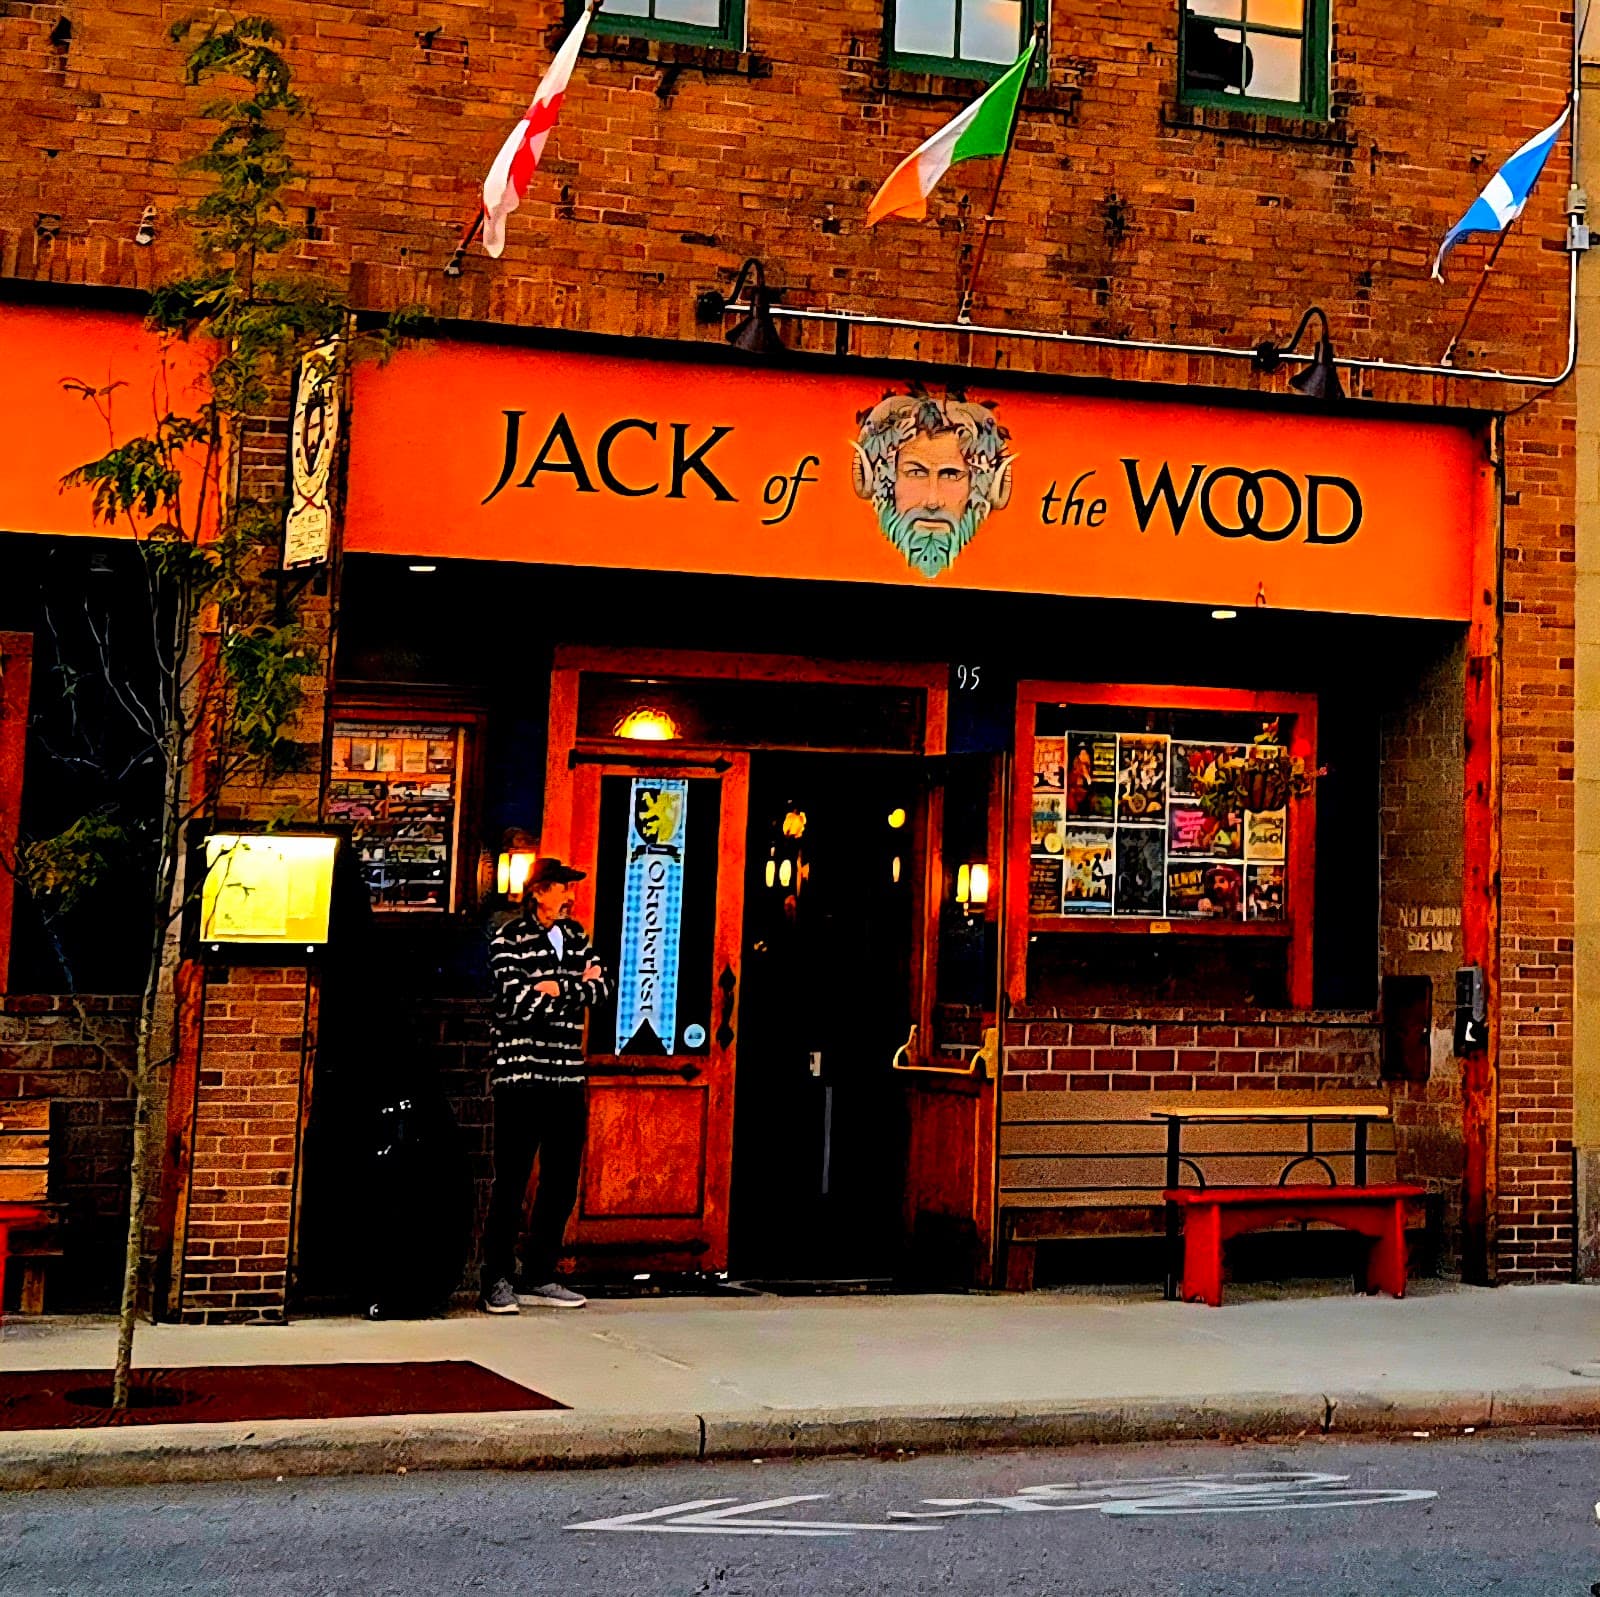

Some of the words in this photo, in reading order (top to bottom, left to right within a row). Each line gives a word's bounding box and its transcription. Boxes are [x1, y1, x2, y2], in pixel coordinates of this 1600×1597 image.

[481, 410, 738, 505] JACK
[761, 455, 819, 525] of
[1041, 470, 1107, 527] the
[1120, 458, 1363, 544] WOOD
[957, 664, 981, 690] 95
[638, 860, 665, 1012] Oktoberfest
